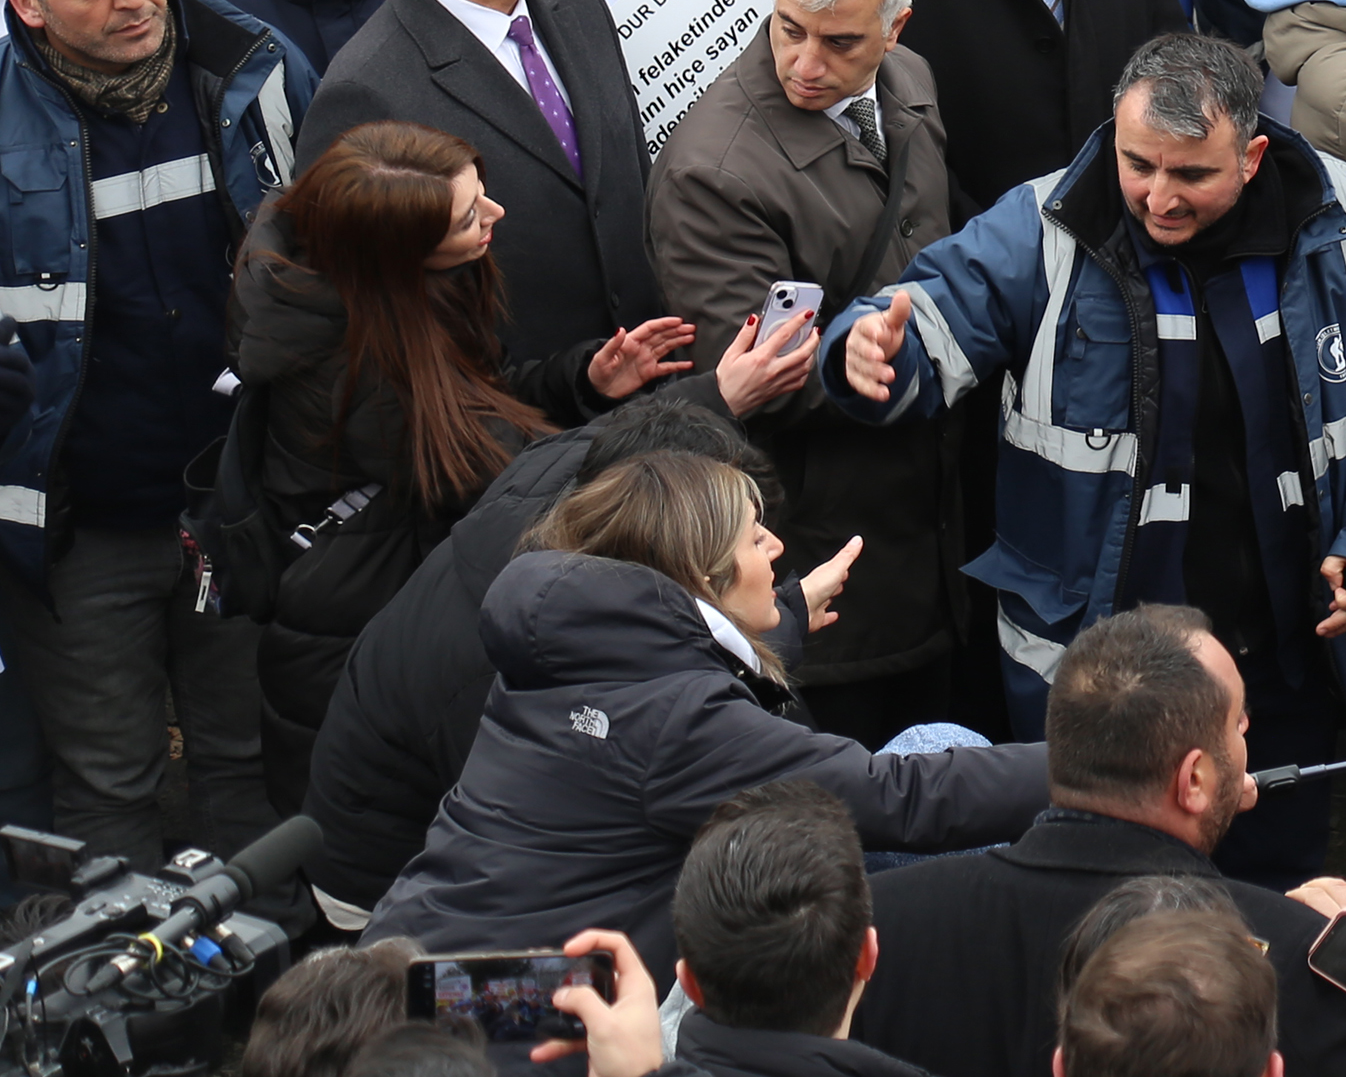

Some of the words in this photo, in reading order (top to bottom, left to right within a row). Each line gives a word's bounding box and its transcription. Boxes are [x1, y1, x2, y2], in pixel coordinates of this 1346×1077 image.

[617, 3, 655, 40] DUR
[663, 58, 705, 100] hiçe
[705, 6, 760, 61] sayan
[569, 711, 595, 728] NORTH
[583, 705, 599, 718] THE
[572, 721, 594, 735] FACE
